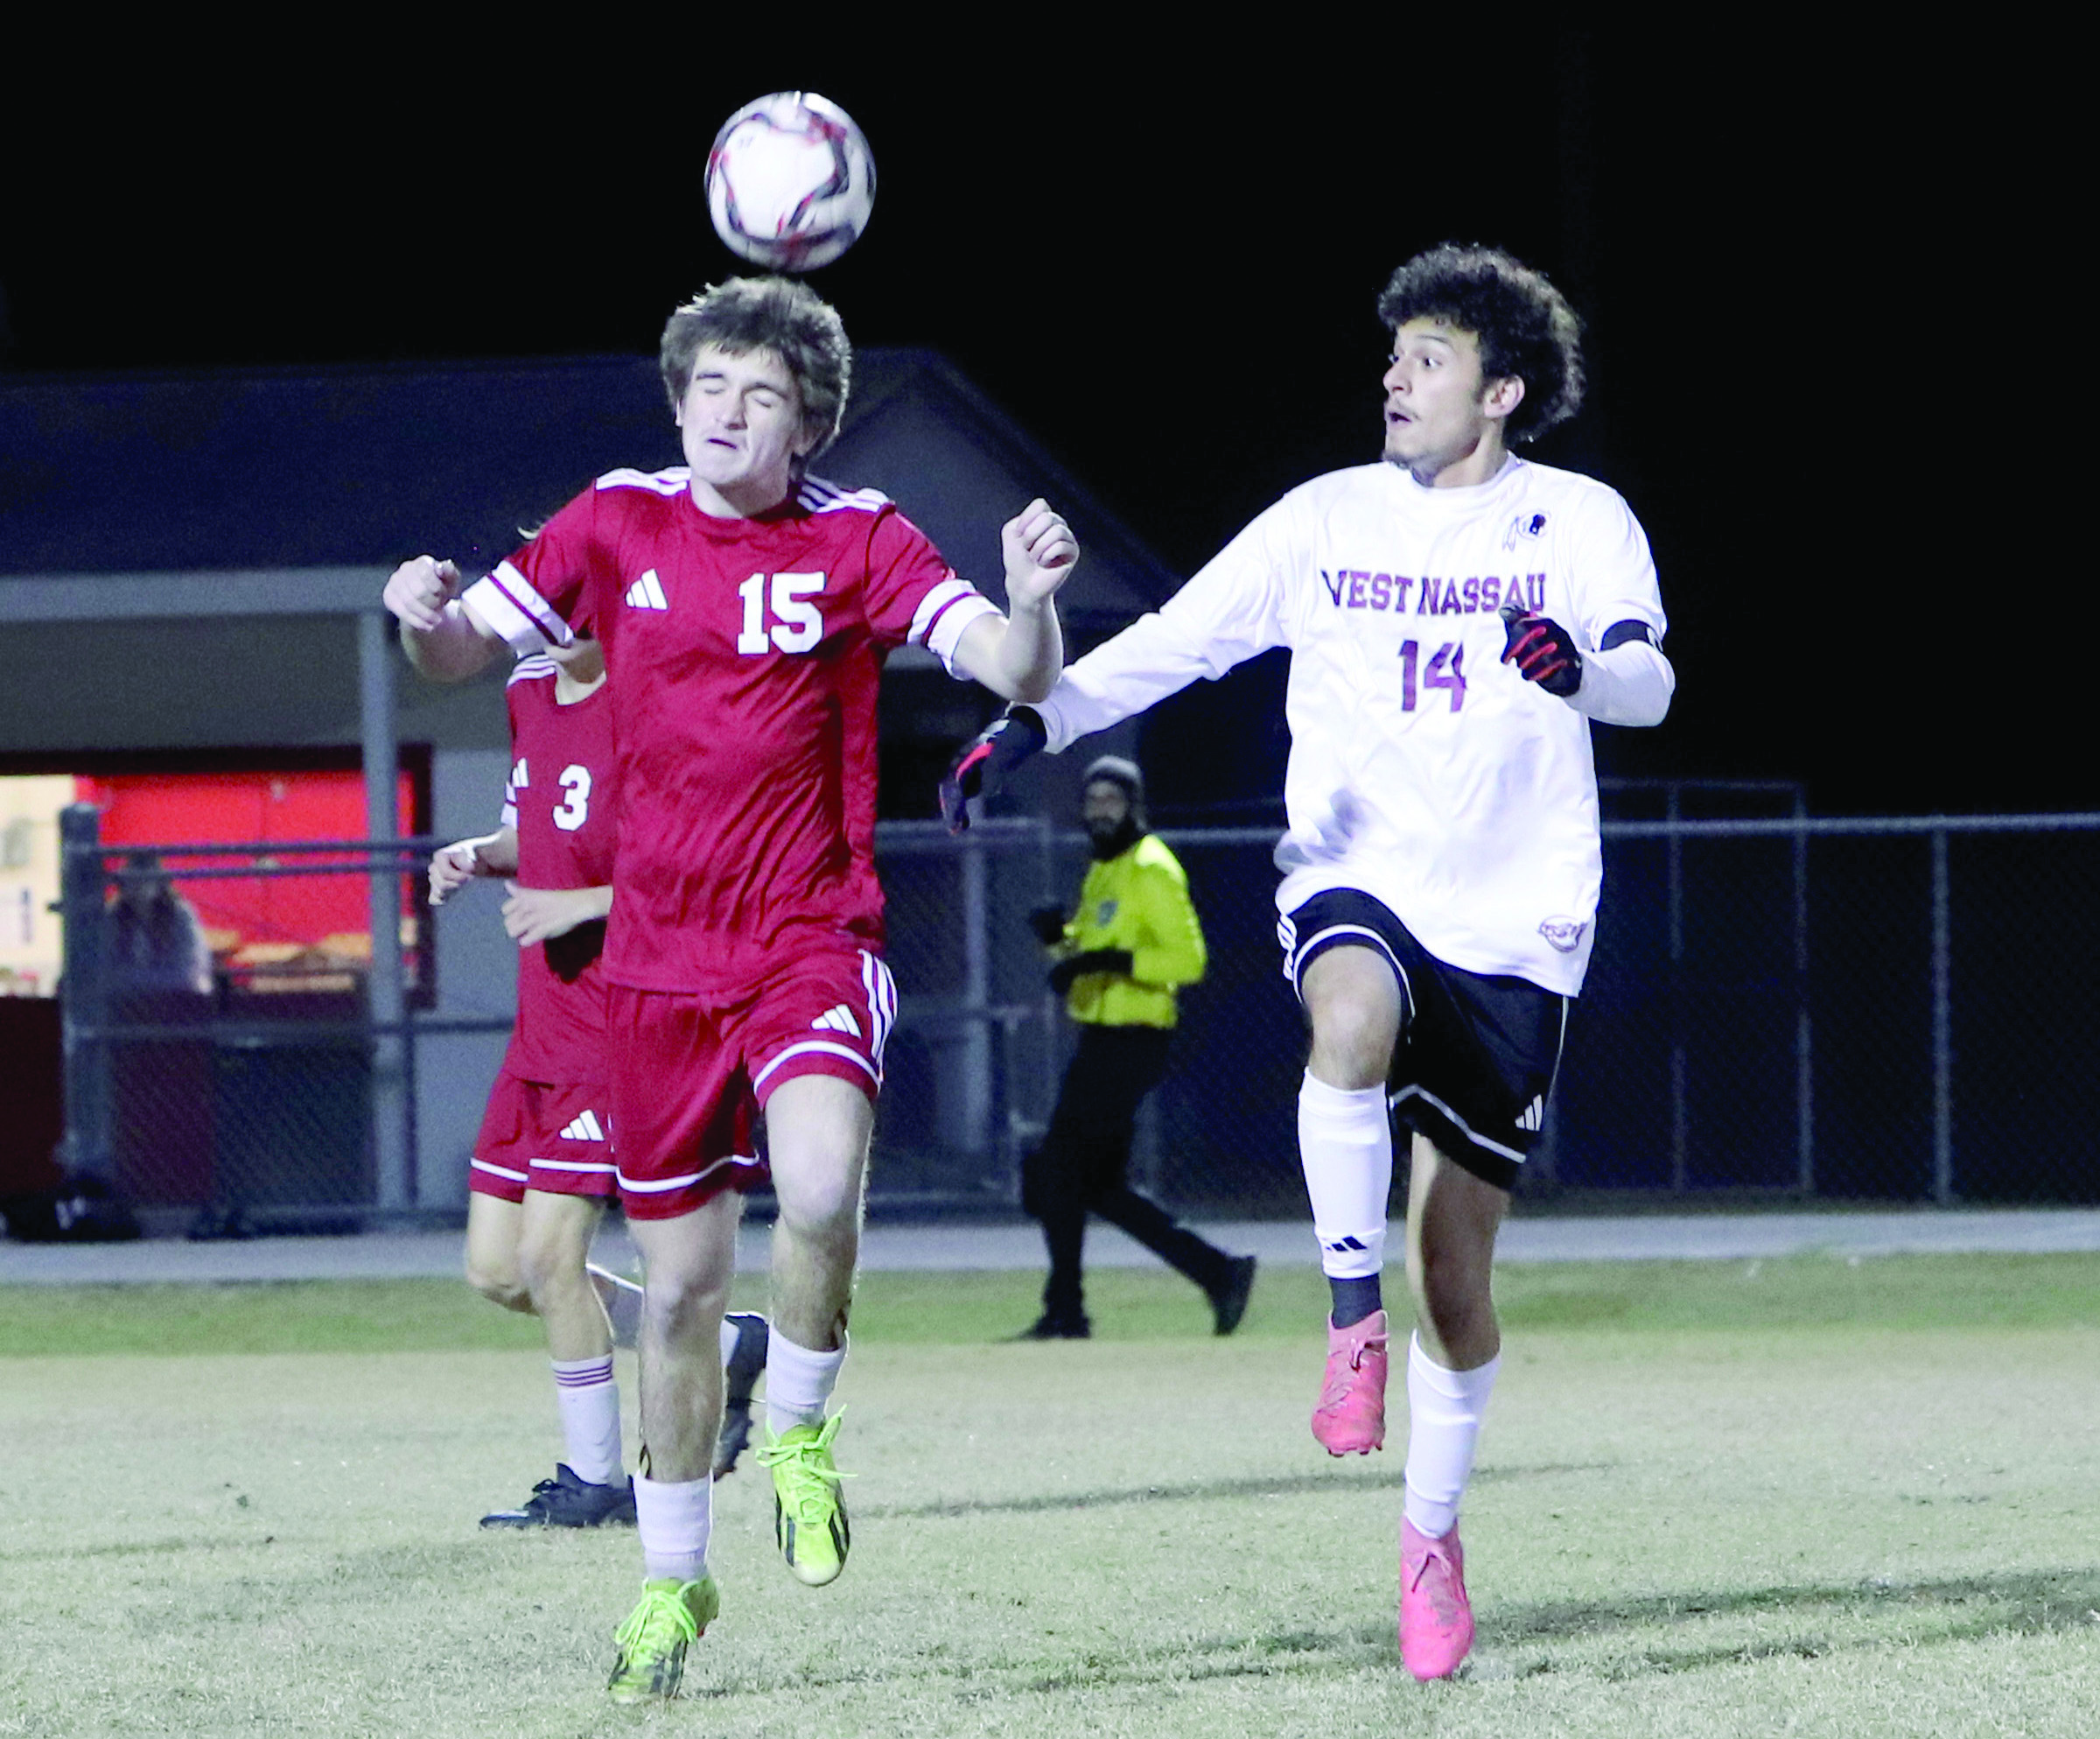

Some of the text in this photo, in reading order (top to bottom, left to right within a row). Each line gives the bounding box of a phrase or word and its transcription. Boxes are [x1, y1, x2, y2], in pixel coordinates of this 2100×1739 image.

[737, 571, 826, 654] 15
[1417, 573, 1546, 615] NASSAU
[1398, 639, 1467, 712] 14
[552, 764, 592, 831] 3
